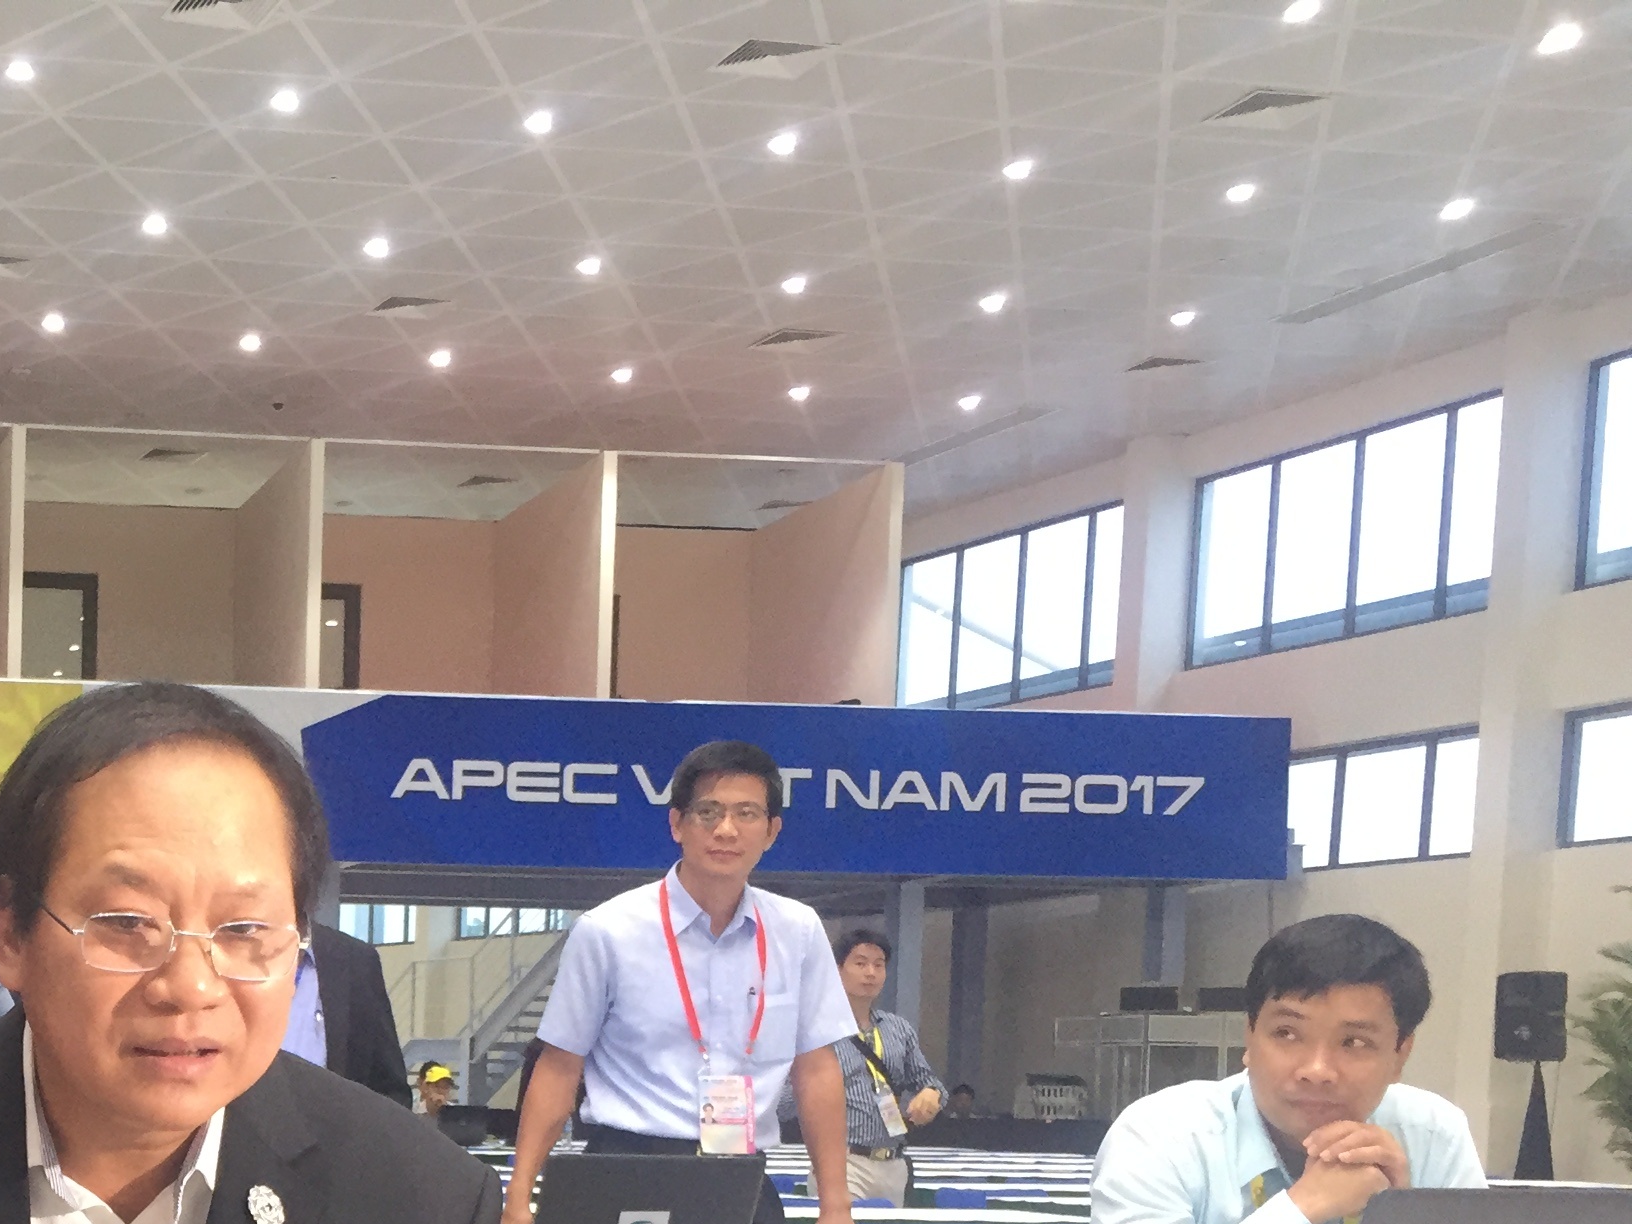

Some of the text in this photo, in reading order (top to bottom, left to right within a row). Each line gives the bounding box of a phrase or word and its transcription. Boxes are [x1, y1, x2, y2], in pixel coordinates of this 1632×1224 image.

[390, 757, 1206, 816] APEC VT NAM 2017
